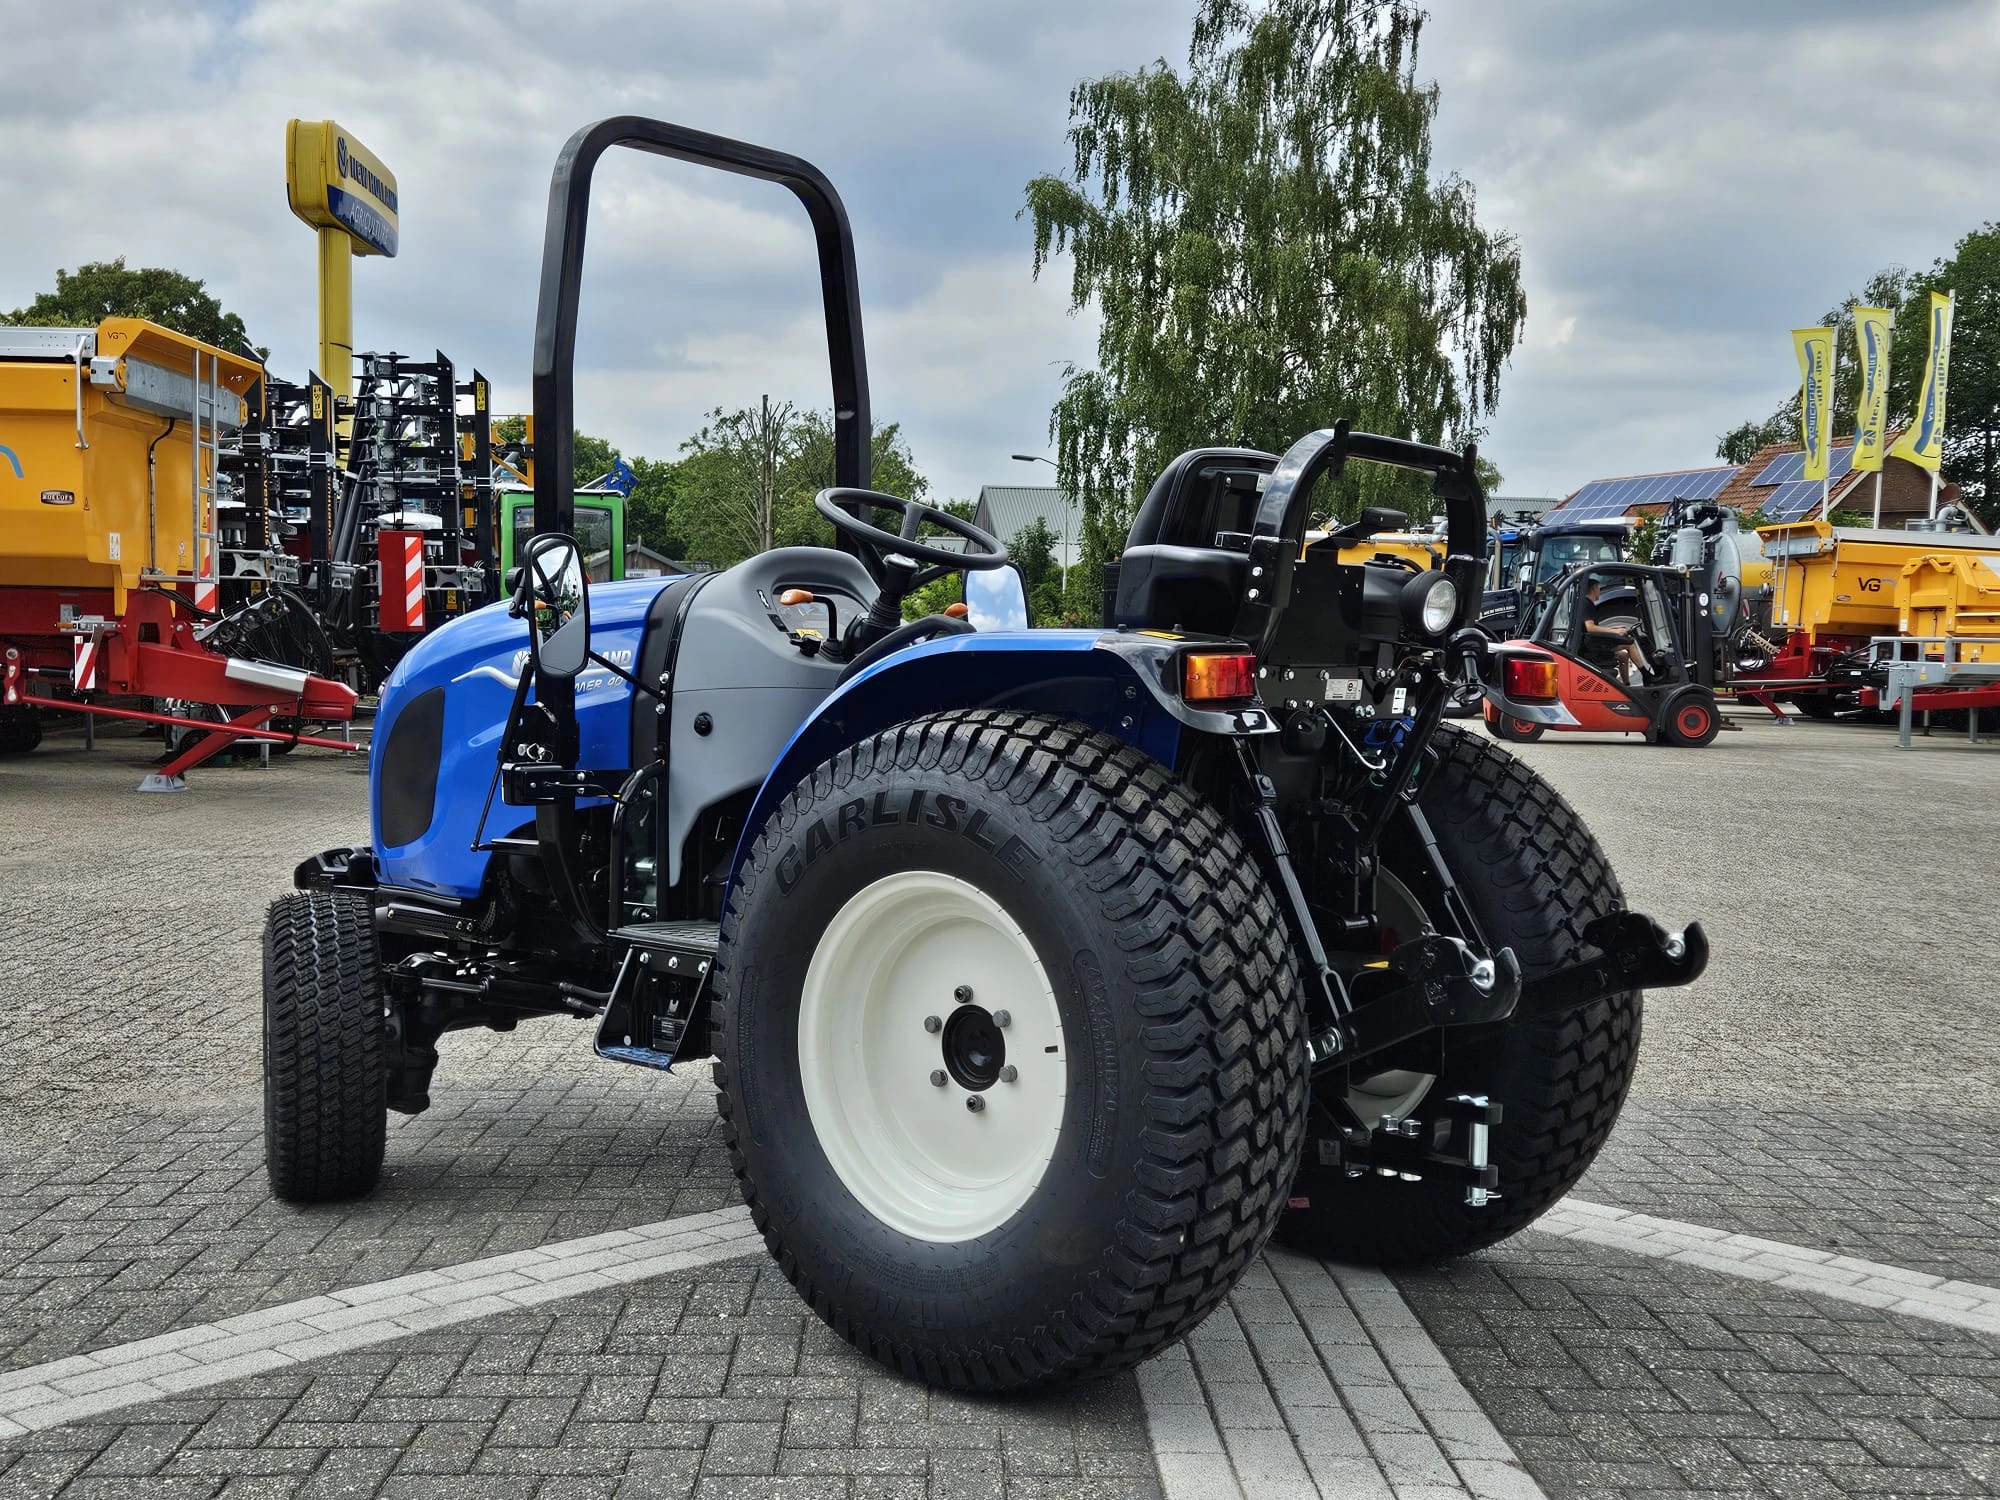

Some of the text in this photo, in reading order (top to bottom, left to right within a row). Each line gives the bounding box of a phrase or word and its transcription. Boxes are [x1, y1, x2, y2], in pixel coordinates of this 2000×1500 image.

[349, 155, 367, 189] NEW
[575, 679, 602, 692] MER
[775, 788, 1042, 897] CARLISLE
